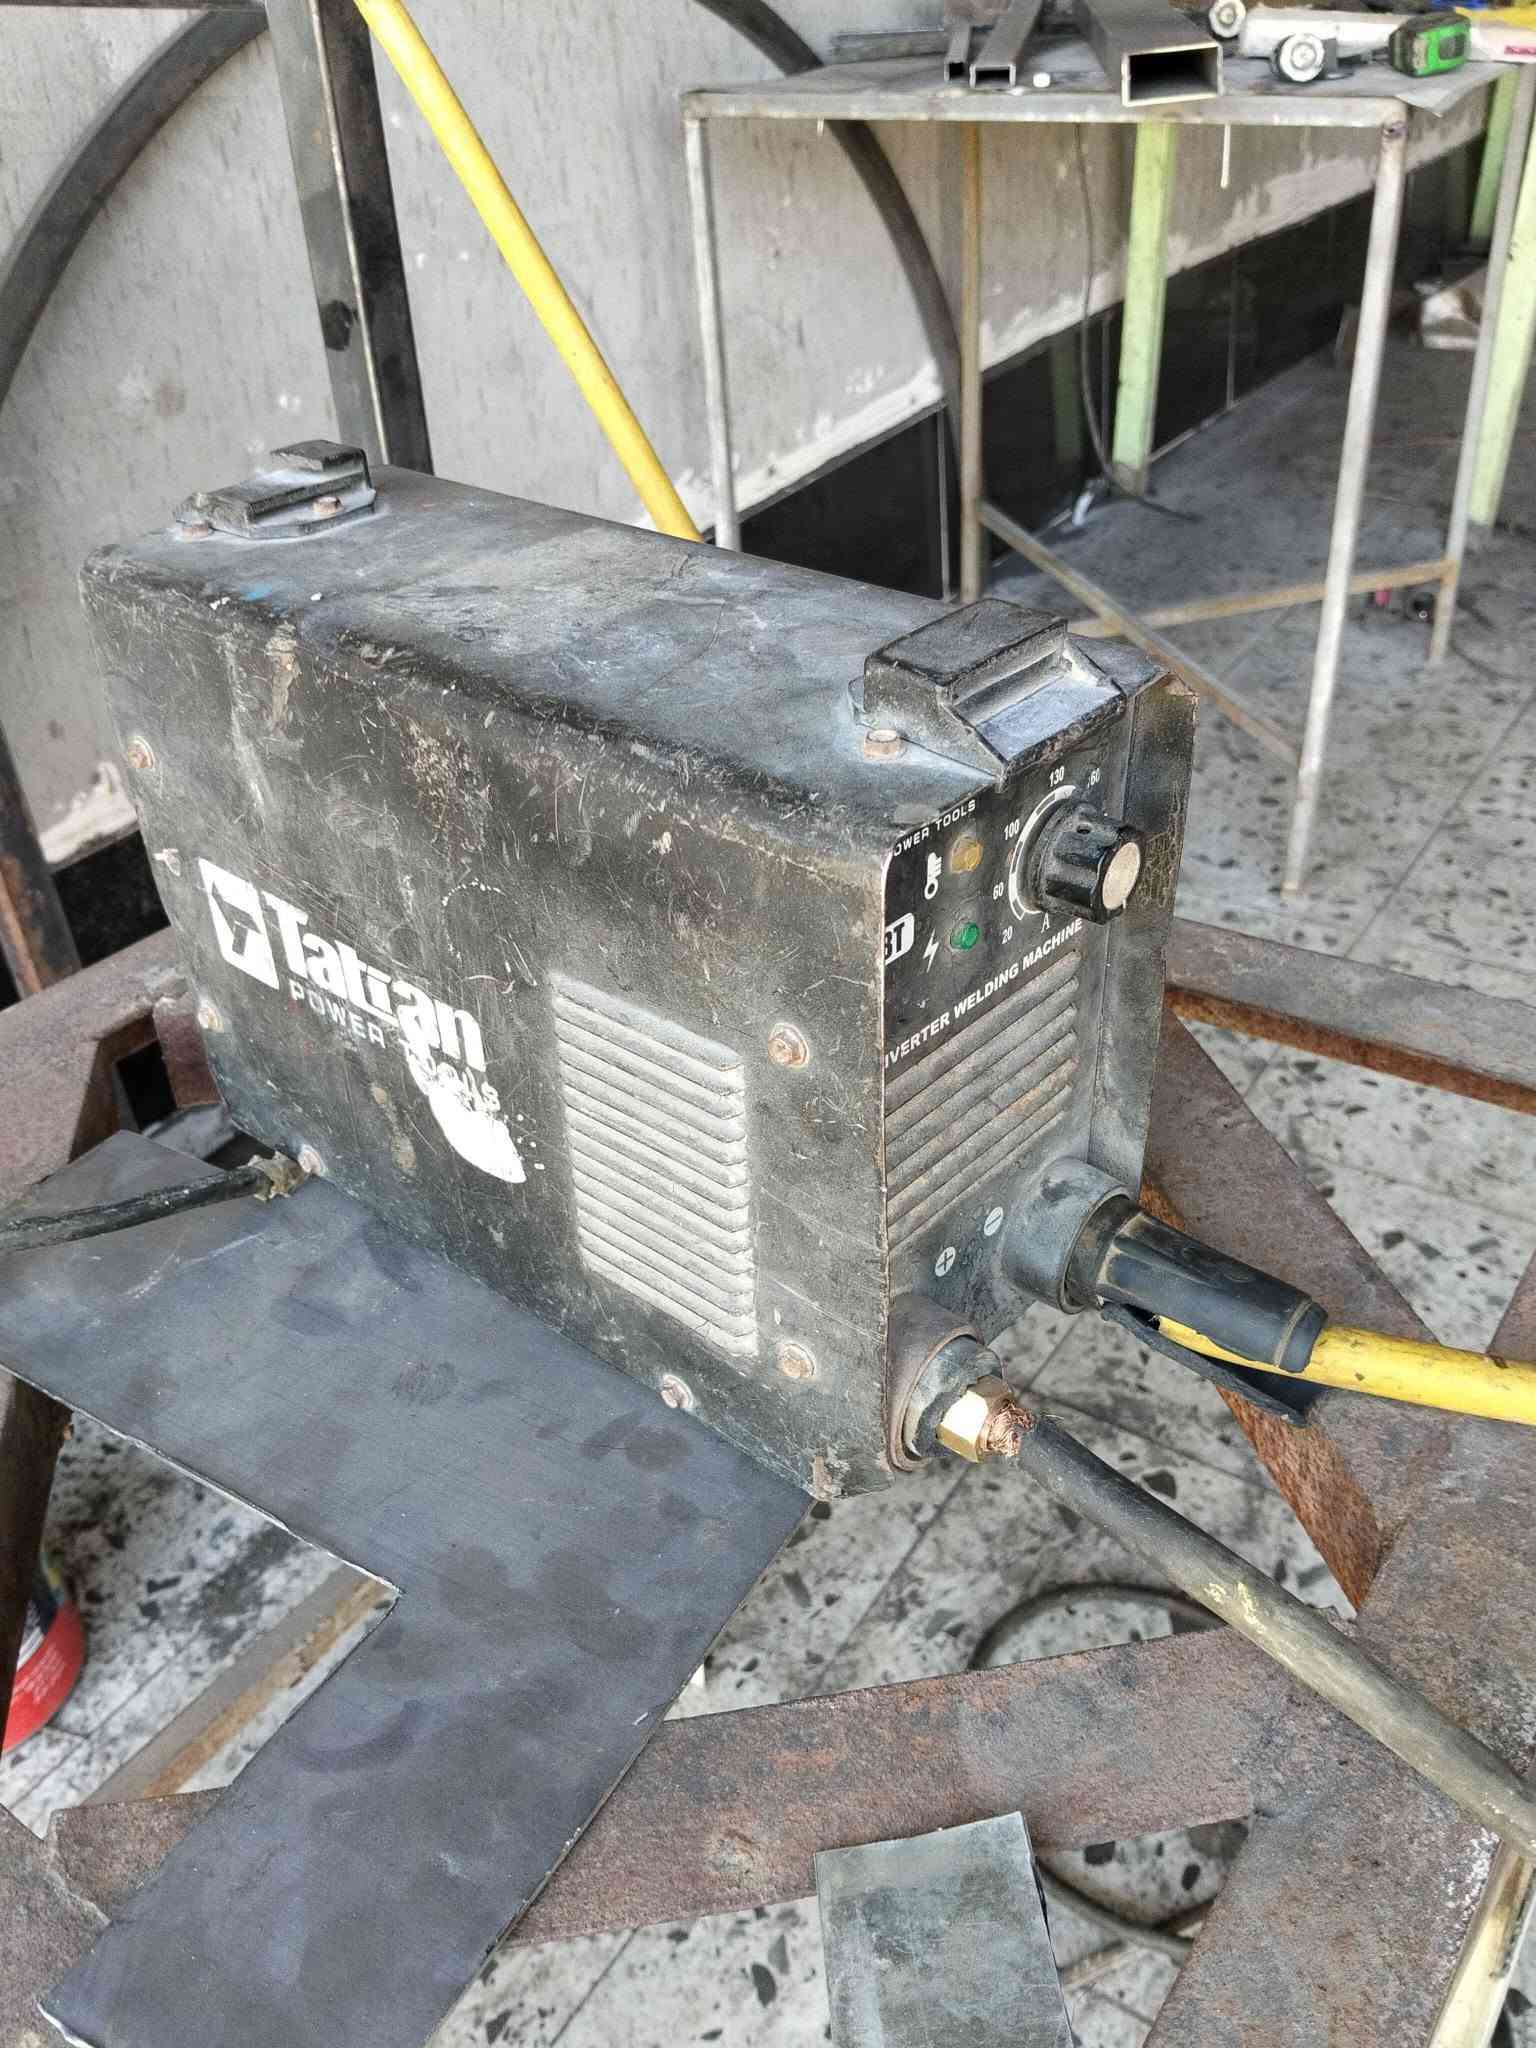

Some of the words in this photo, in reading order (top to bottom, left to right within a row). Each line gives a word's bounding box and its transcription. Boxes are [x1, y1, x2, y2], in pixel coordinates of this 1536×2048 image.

[1050, 766, 1065, 786] 130
[894, 827, 930, 857] OWER
[936, 800, 976, 832] TOOLS
[1004, 819, 1020, 841] 100
[992, 882, 1004, 900] 60
[1041, 912, 1050, 933] A
[1001, 926, 1013, 945] 20
[884, 1012, 950, 1069] VERTER
[953, 963, 1019, 1019] WELDING
[1022, 918, 1083, 971] MACHINE
[289, 978, 386, 1049] POWER
